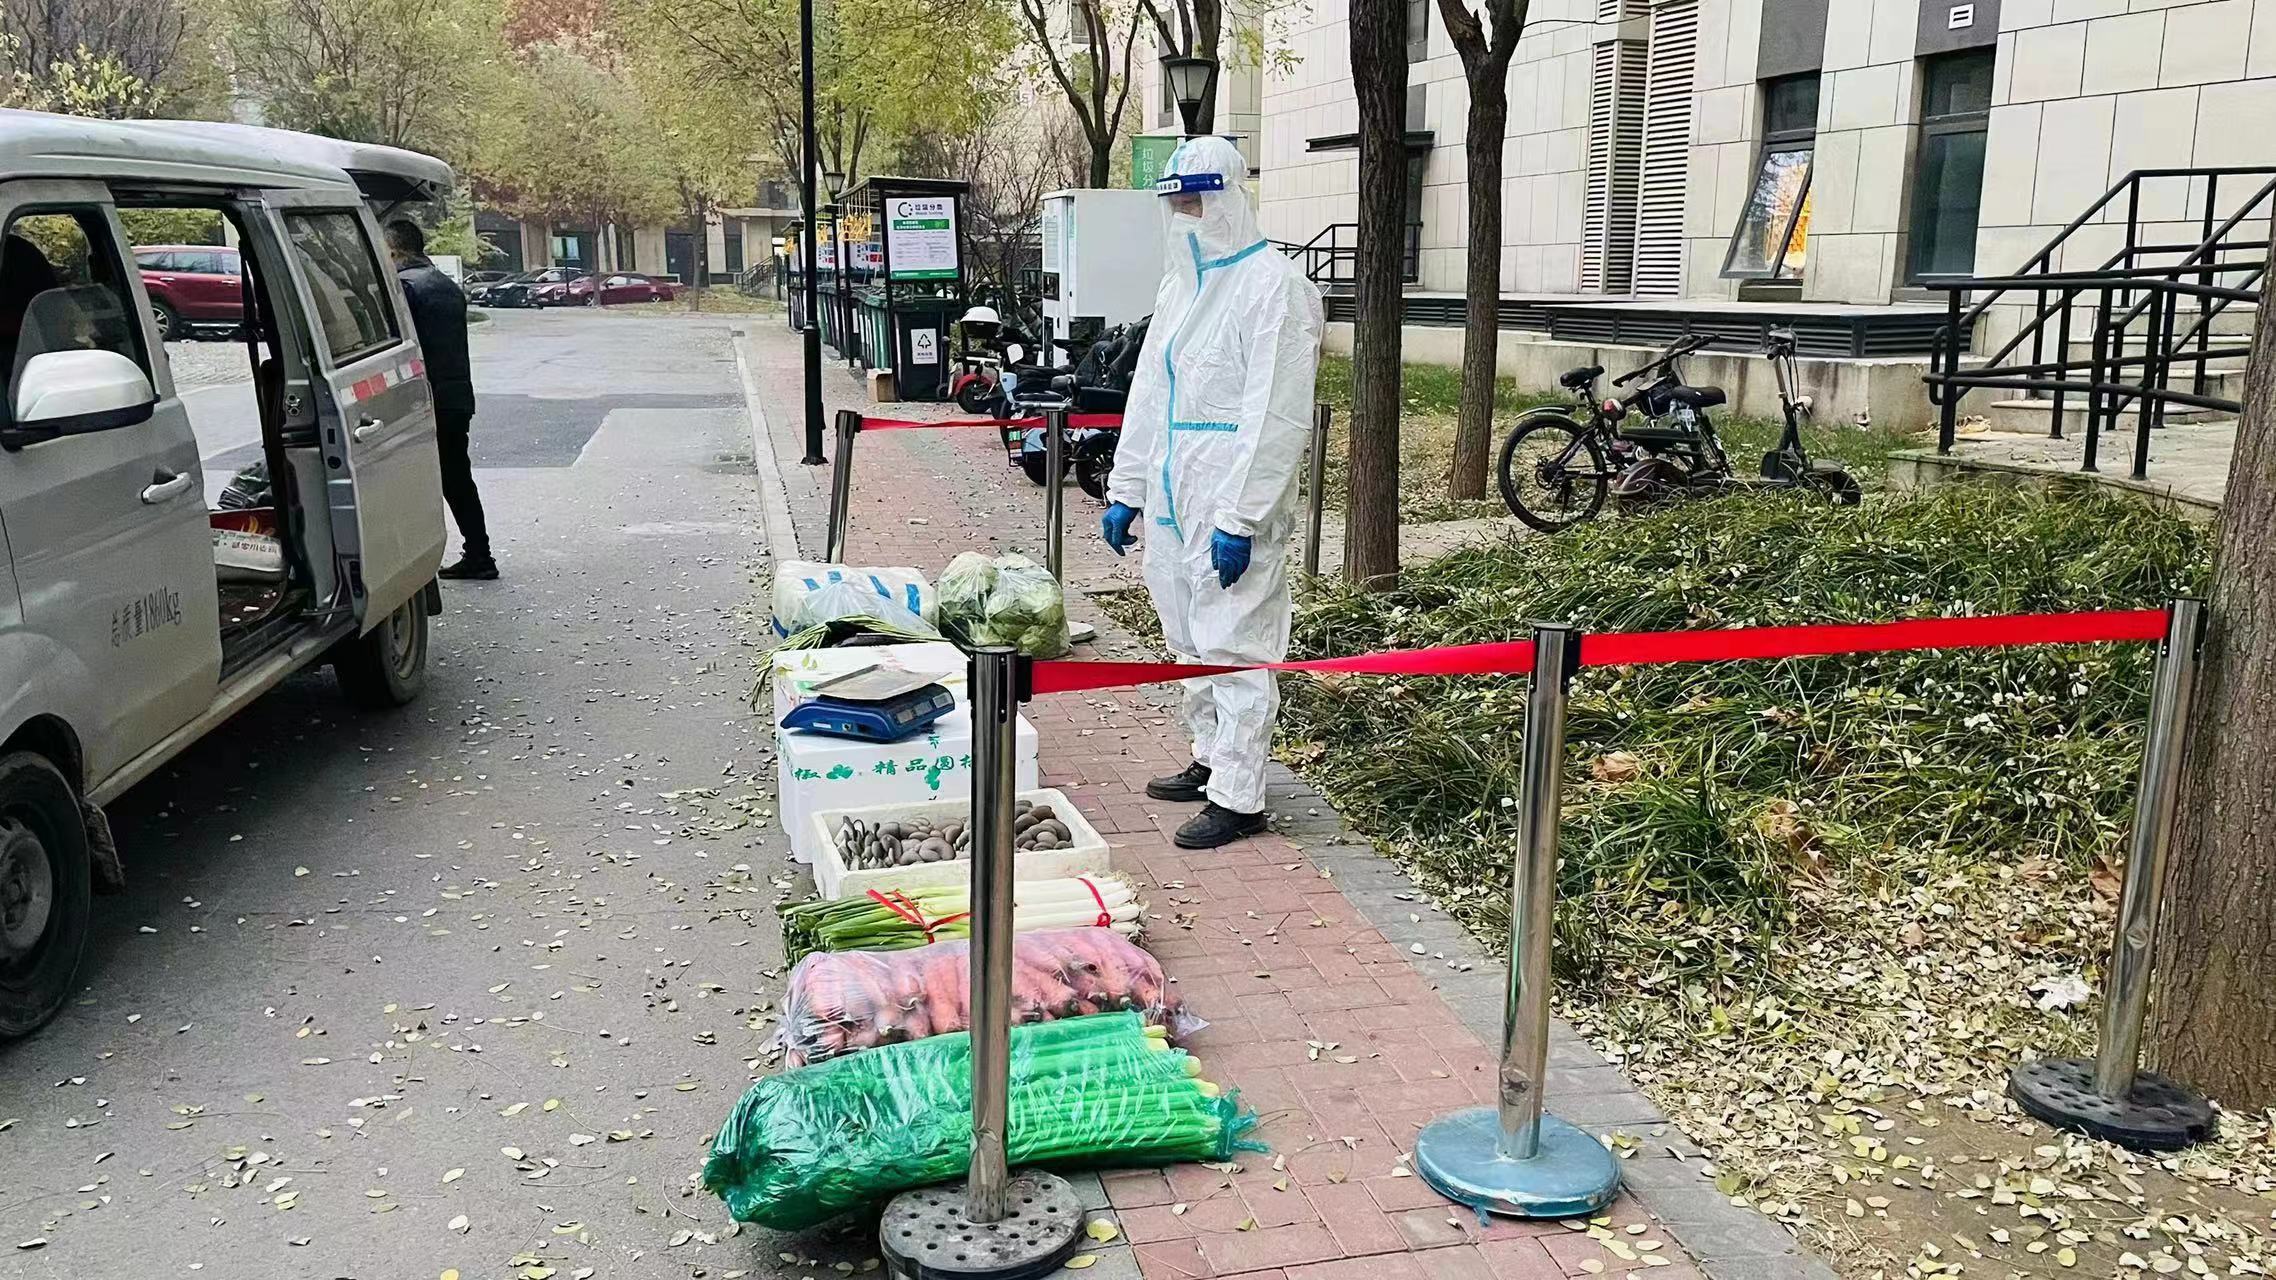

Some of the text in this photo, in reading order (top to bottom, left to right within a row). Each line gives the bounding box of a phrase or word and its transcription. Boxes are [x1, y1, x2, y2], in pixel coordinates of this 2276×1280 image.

[1142, 147, 1154, 190] 垃圾分
[915, 203, 943, 211] 垃圾分类
